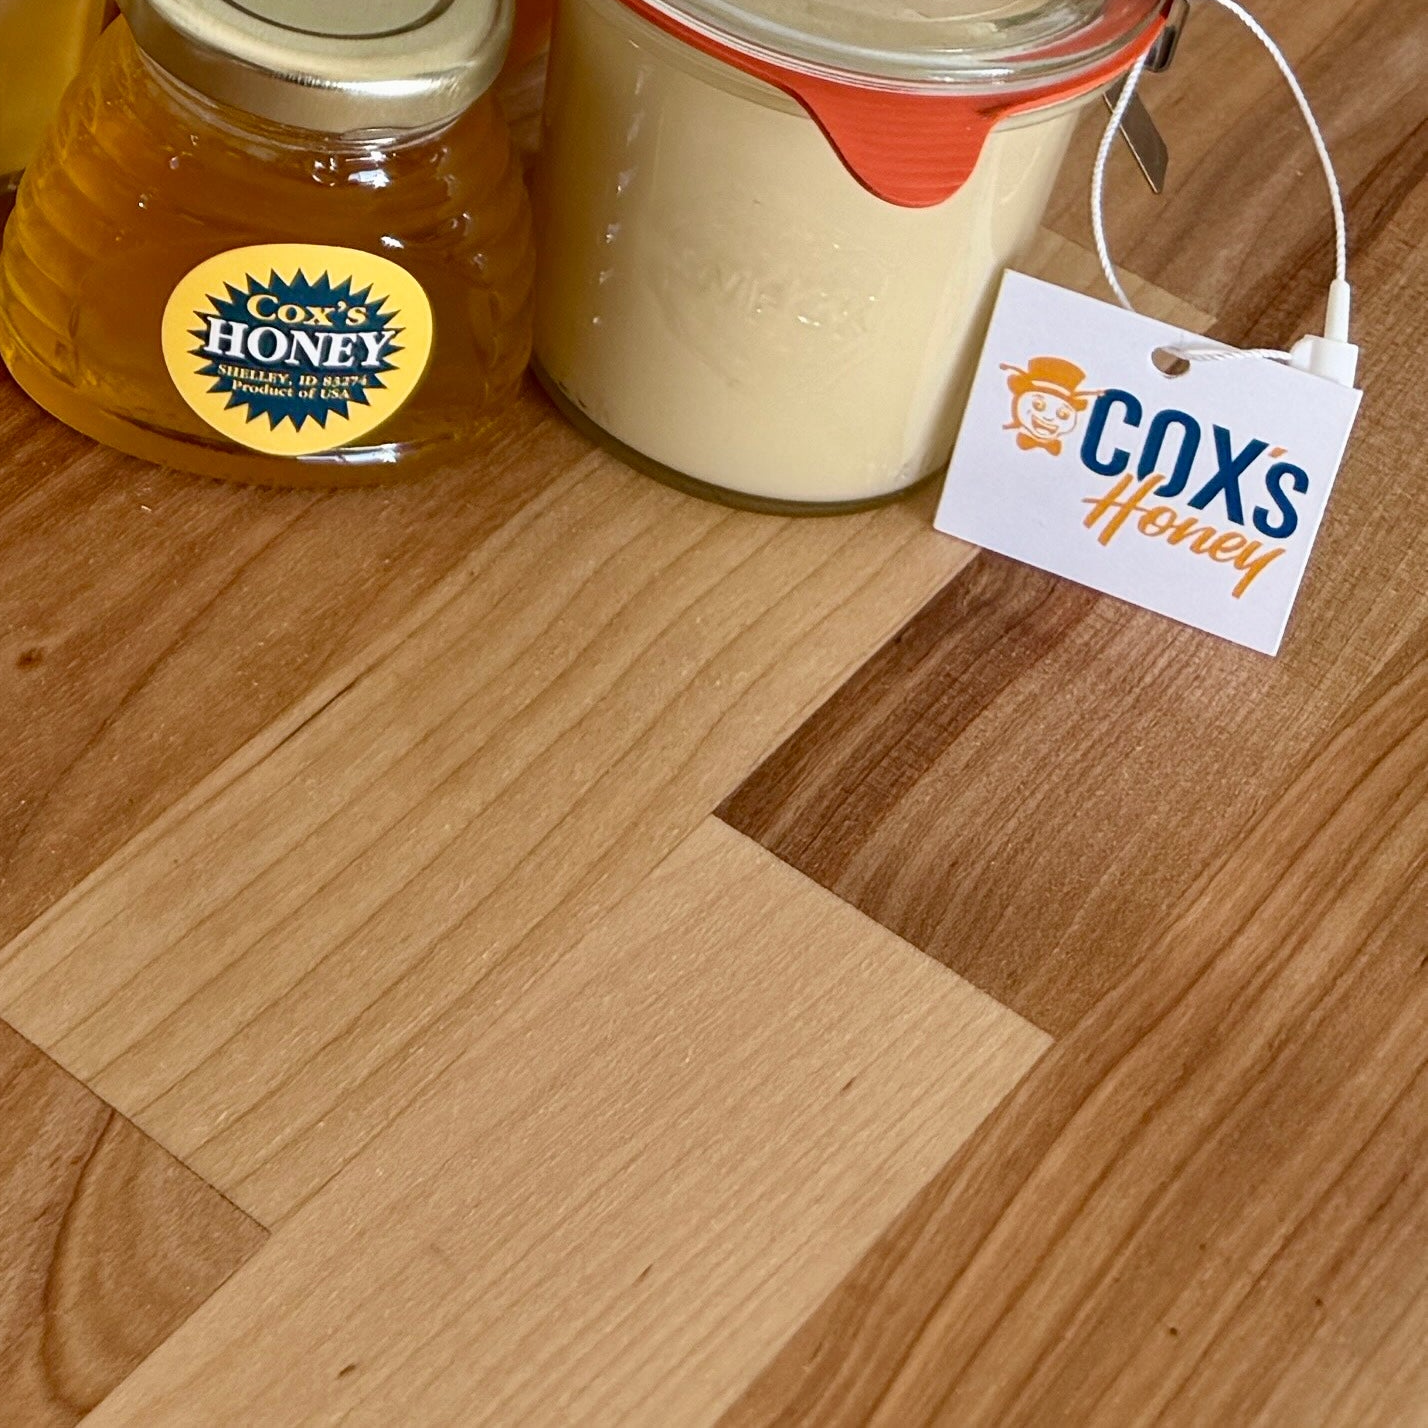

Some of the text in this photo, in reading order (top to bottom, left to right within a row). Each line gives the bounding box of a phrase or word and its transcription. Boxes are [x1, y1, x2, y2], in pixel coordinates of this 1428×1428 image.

[203, 315, 397, 369] HONEY
[217, 363, 293, 386] SHELLEY,
[298, 374, 318, 386] ID
[231, 378, 350, 400] Product of USA
[1081, 473, 1287, 600] Honey
